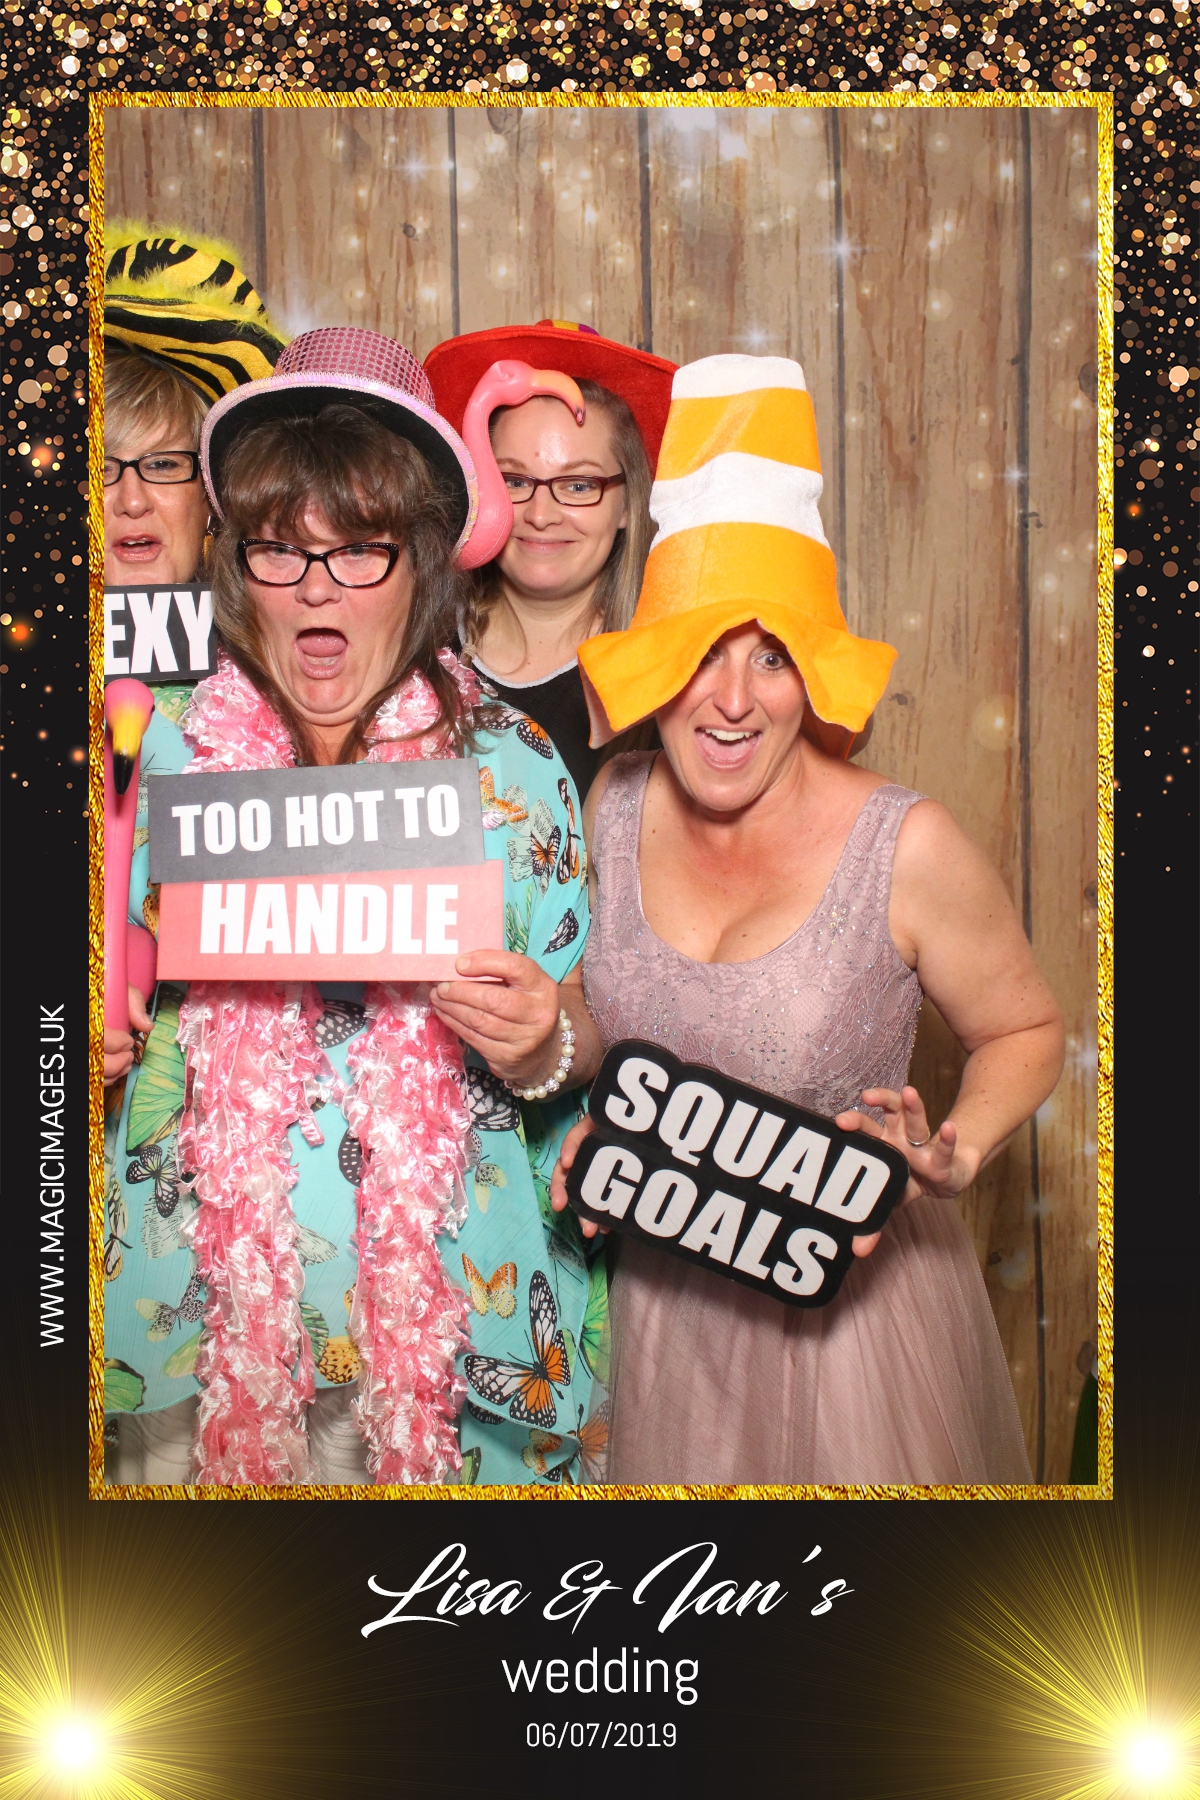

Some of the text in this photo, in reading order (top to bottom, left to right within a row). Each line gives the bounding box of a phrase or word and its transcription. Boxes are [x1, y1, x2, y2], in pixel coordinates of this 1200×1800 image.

[171, 784, 460, 857] TOO HOT TO
[200, 883, 459, 955] HANDLE
[604, 1057, 891, 1224] SQUAD
[580, 1145, 839, 1297] GOALS
